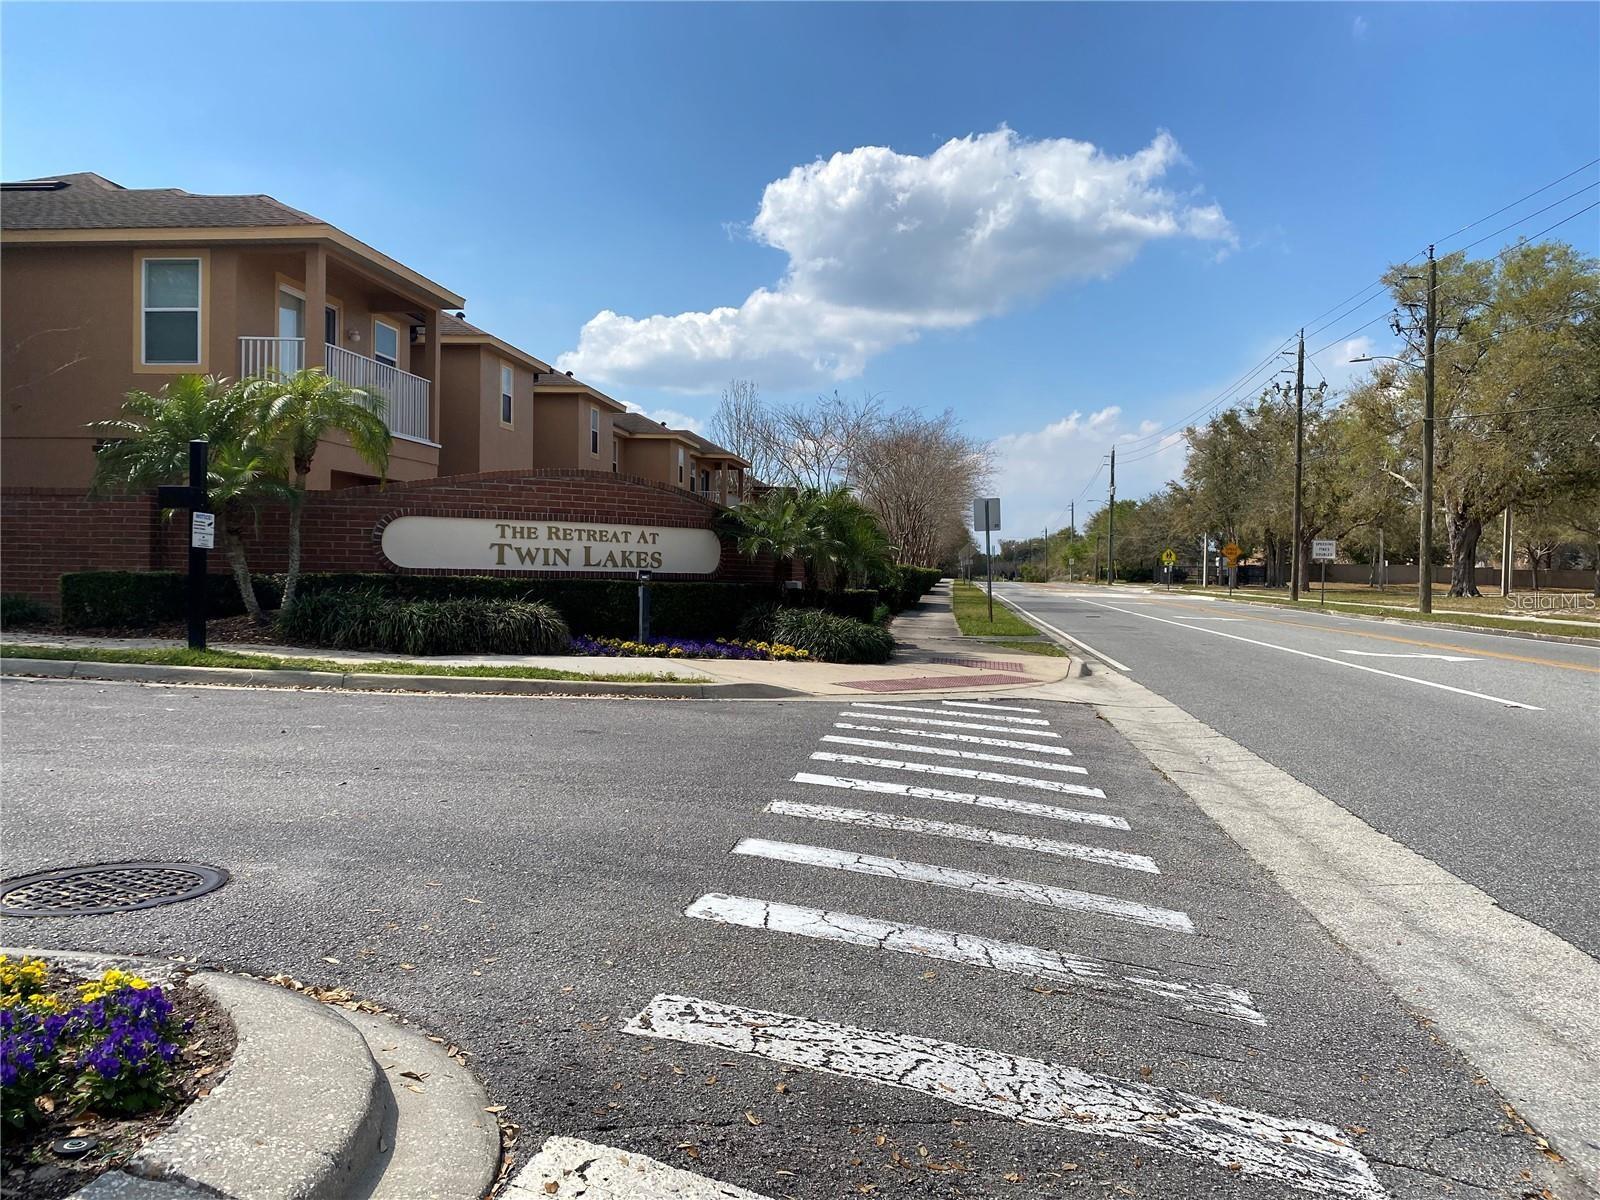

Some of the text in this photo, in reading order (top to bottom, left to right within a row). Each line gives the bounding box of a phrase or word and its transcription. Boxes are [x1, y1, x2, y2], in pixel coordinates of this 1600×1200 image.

[495, 524, 660, 545] THE RETREAT AT
[489, 542, 663, 569] TWIN LAKES
